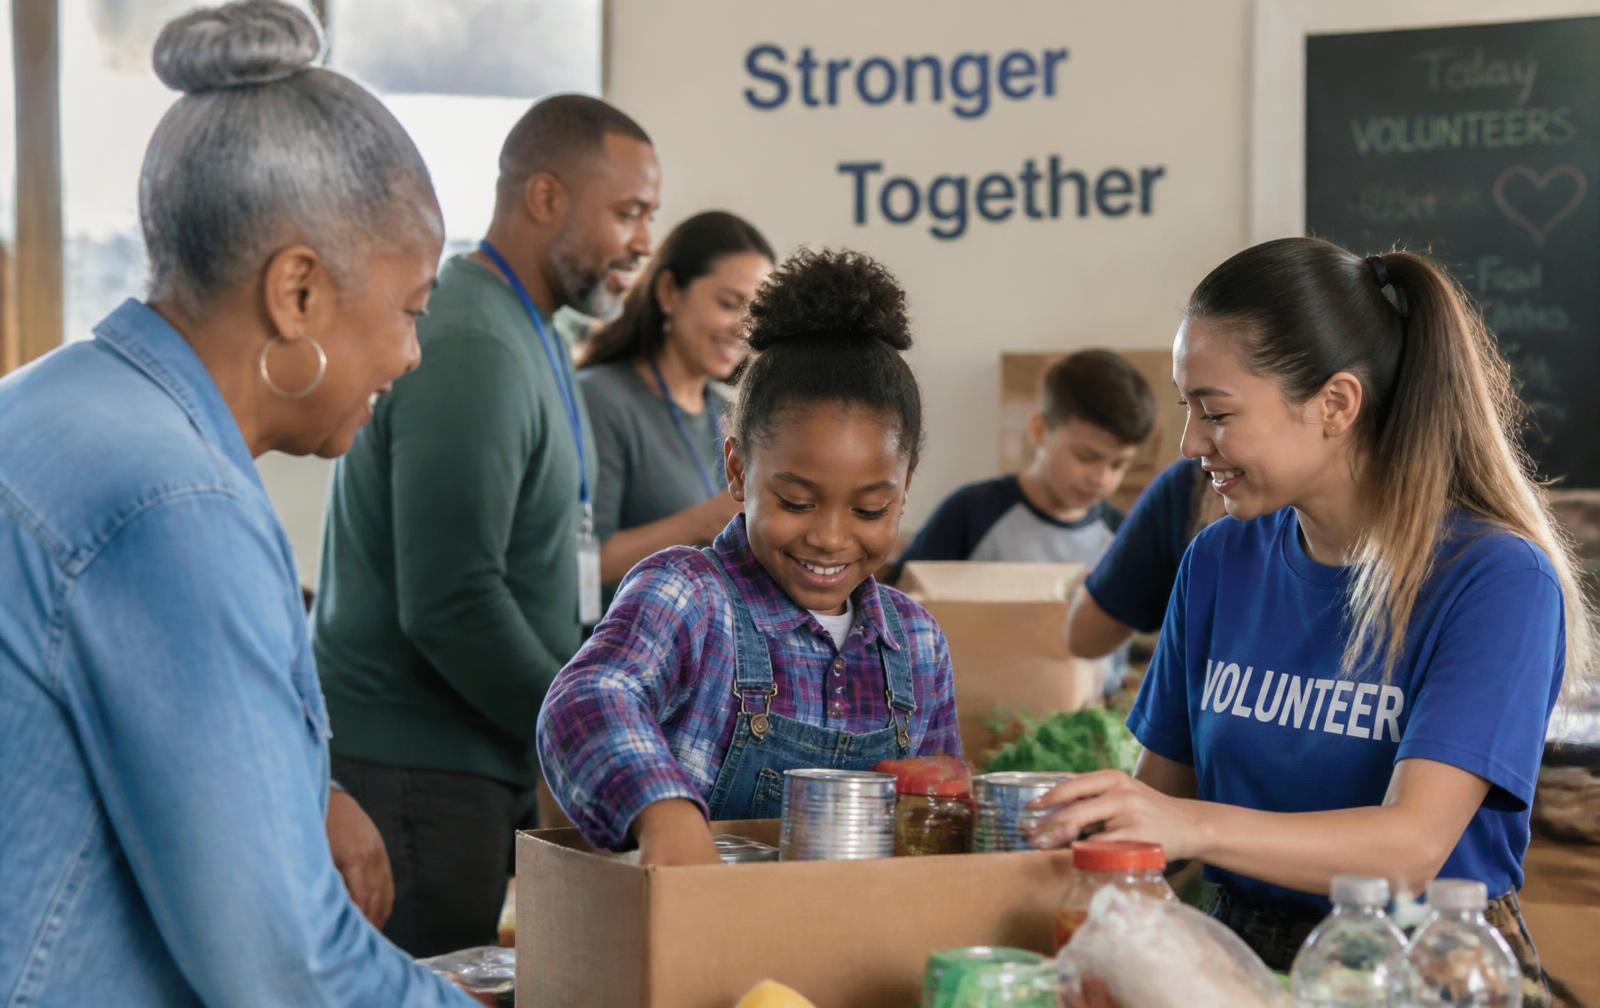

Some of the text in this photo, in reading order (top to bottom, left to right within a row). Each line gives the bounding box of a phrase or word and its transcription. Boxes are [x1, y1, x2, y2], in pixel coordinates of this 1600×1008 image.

[743, 43, 1069, 119] Stronger
[1410, 46, 1538, 106] Today
[1350, 107, 1576, 154] VOLUNTEERS
[837, 155, 1166, 241] Together
[1200, 658, 1405, 743] VOLUNTEER
